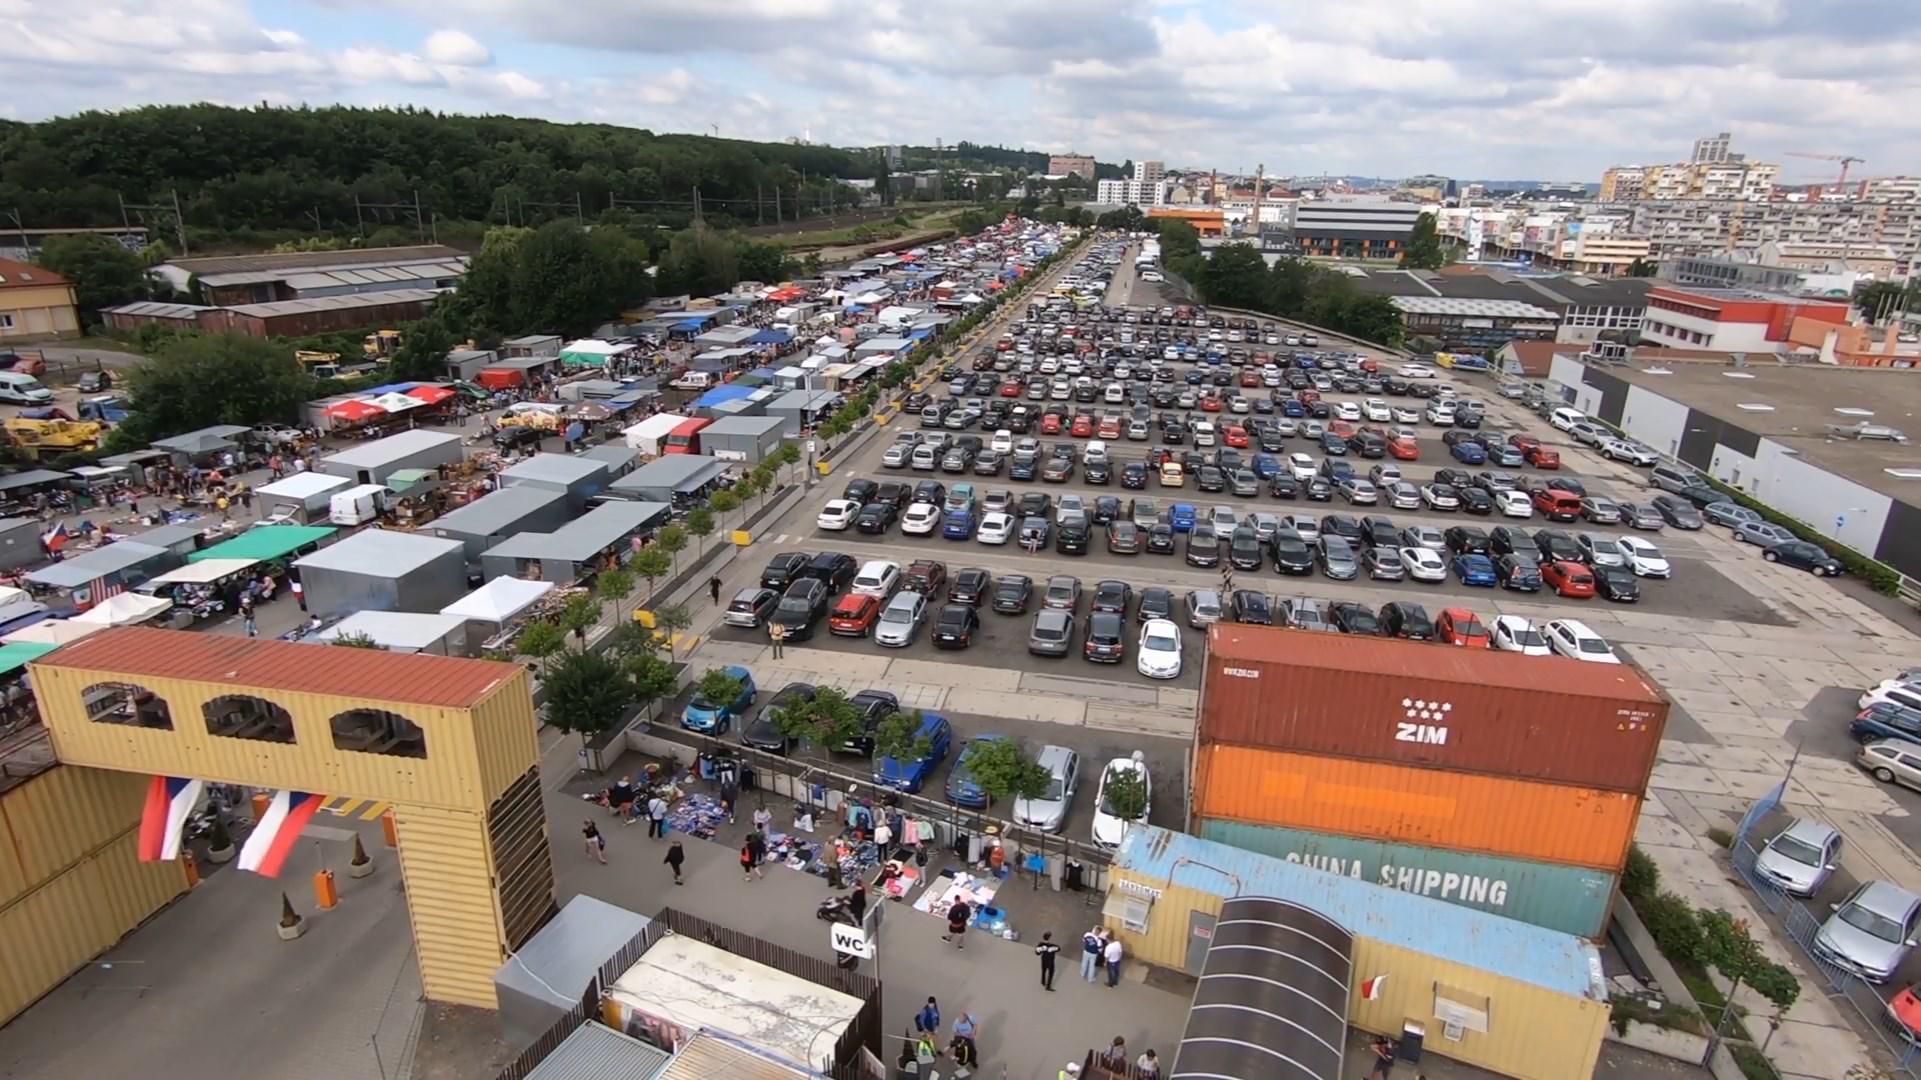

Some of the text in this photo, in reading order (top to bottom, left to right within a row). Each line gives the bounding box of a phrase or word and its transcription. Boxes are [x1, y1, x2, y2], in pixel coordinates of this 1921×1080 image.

[1395, 722, 1448, 745] ZIM
[1378, 864, 1508, 905] SHIPPING
[835, 934, 863, 951] WC
